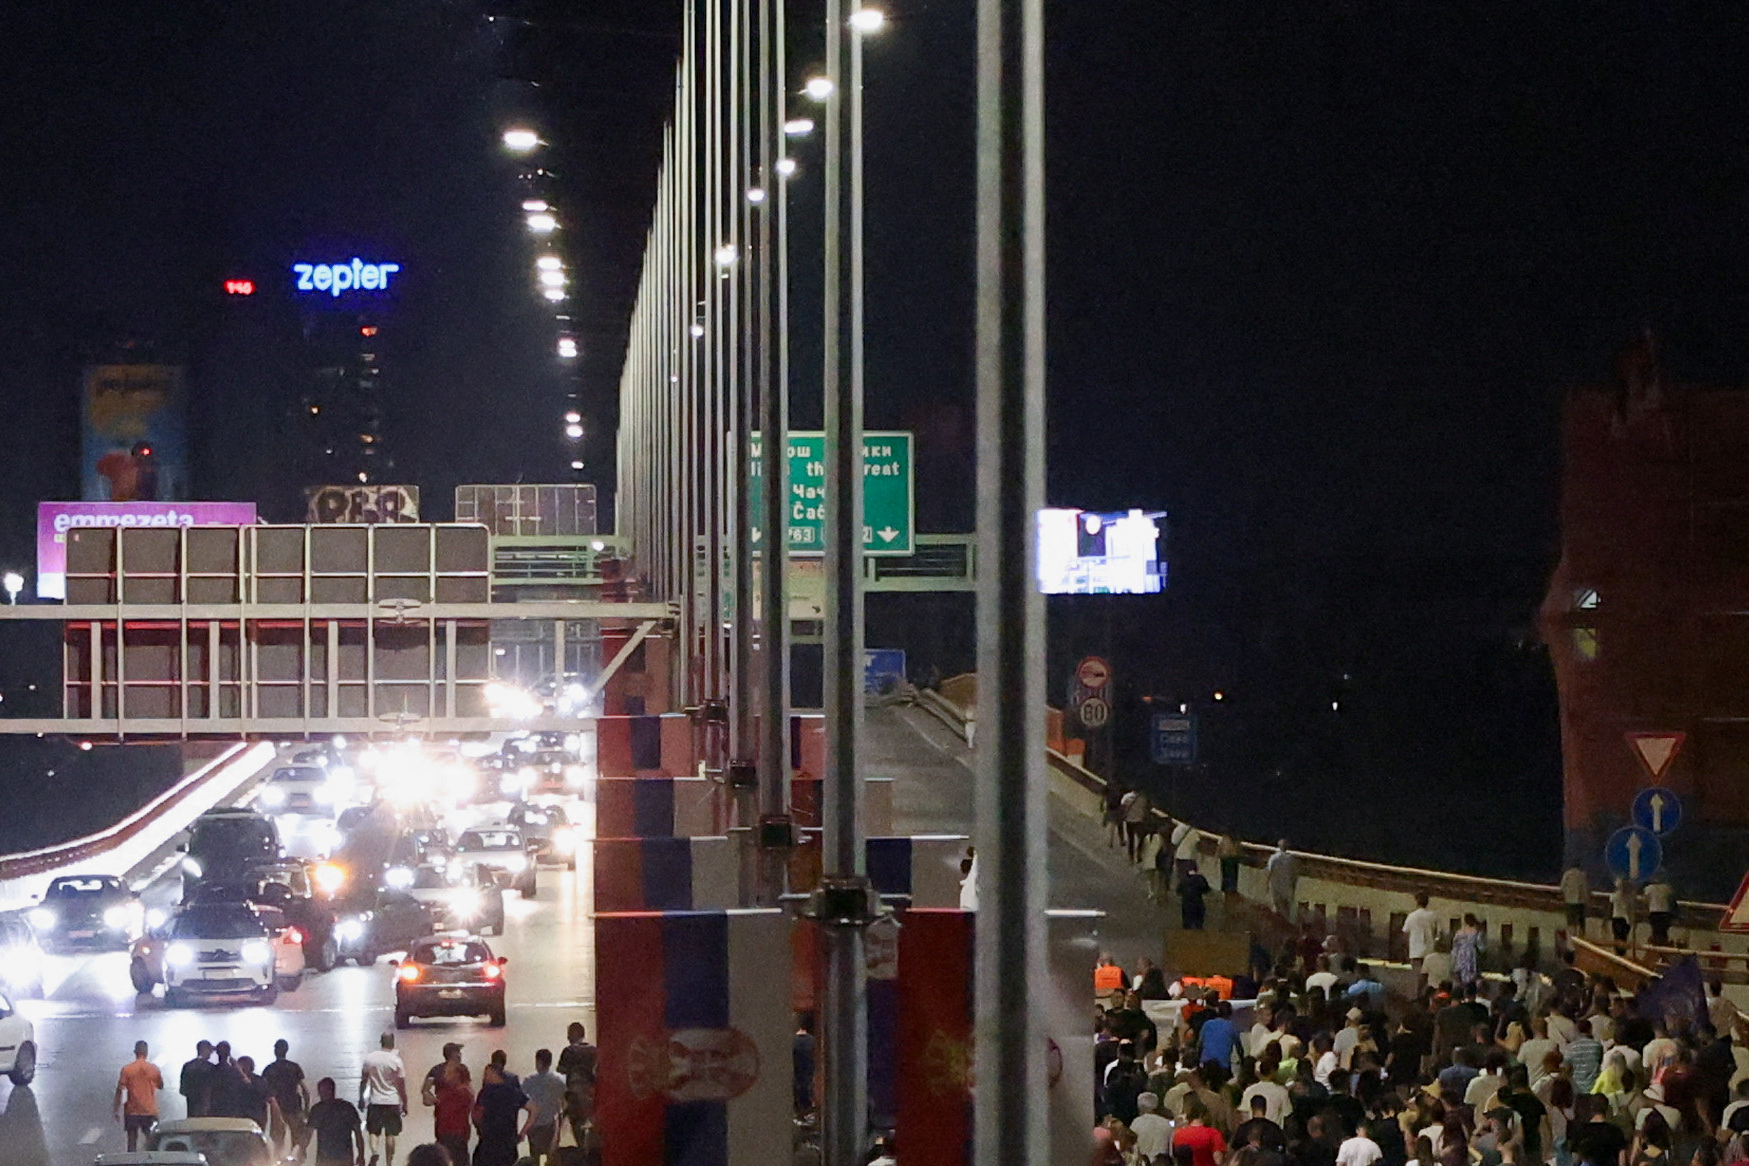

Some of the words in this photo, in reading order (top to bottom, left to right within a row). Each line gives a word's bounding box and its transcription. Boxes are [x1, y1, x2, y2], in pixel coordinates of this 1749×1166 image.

[293, 257, 400, 297] zepter
[806, 460, 826, 477] th
[862, 461, 900, 476] reat
[54, 510, 194, 532] emmezeta
